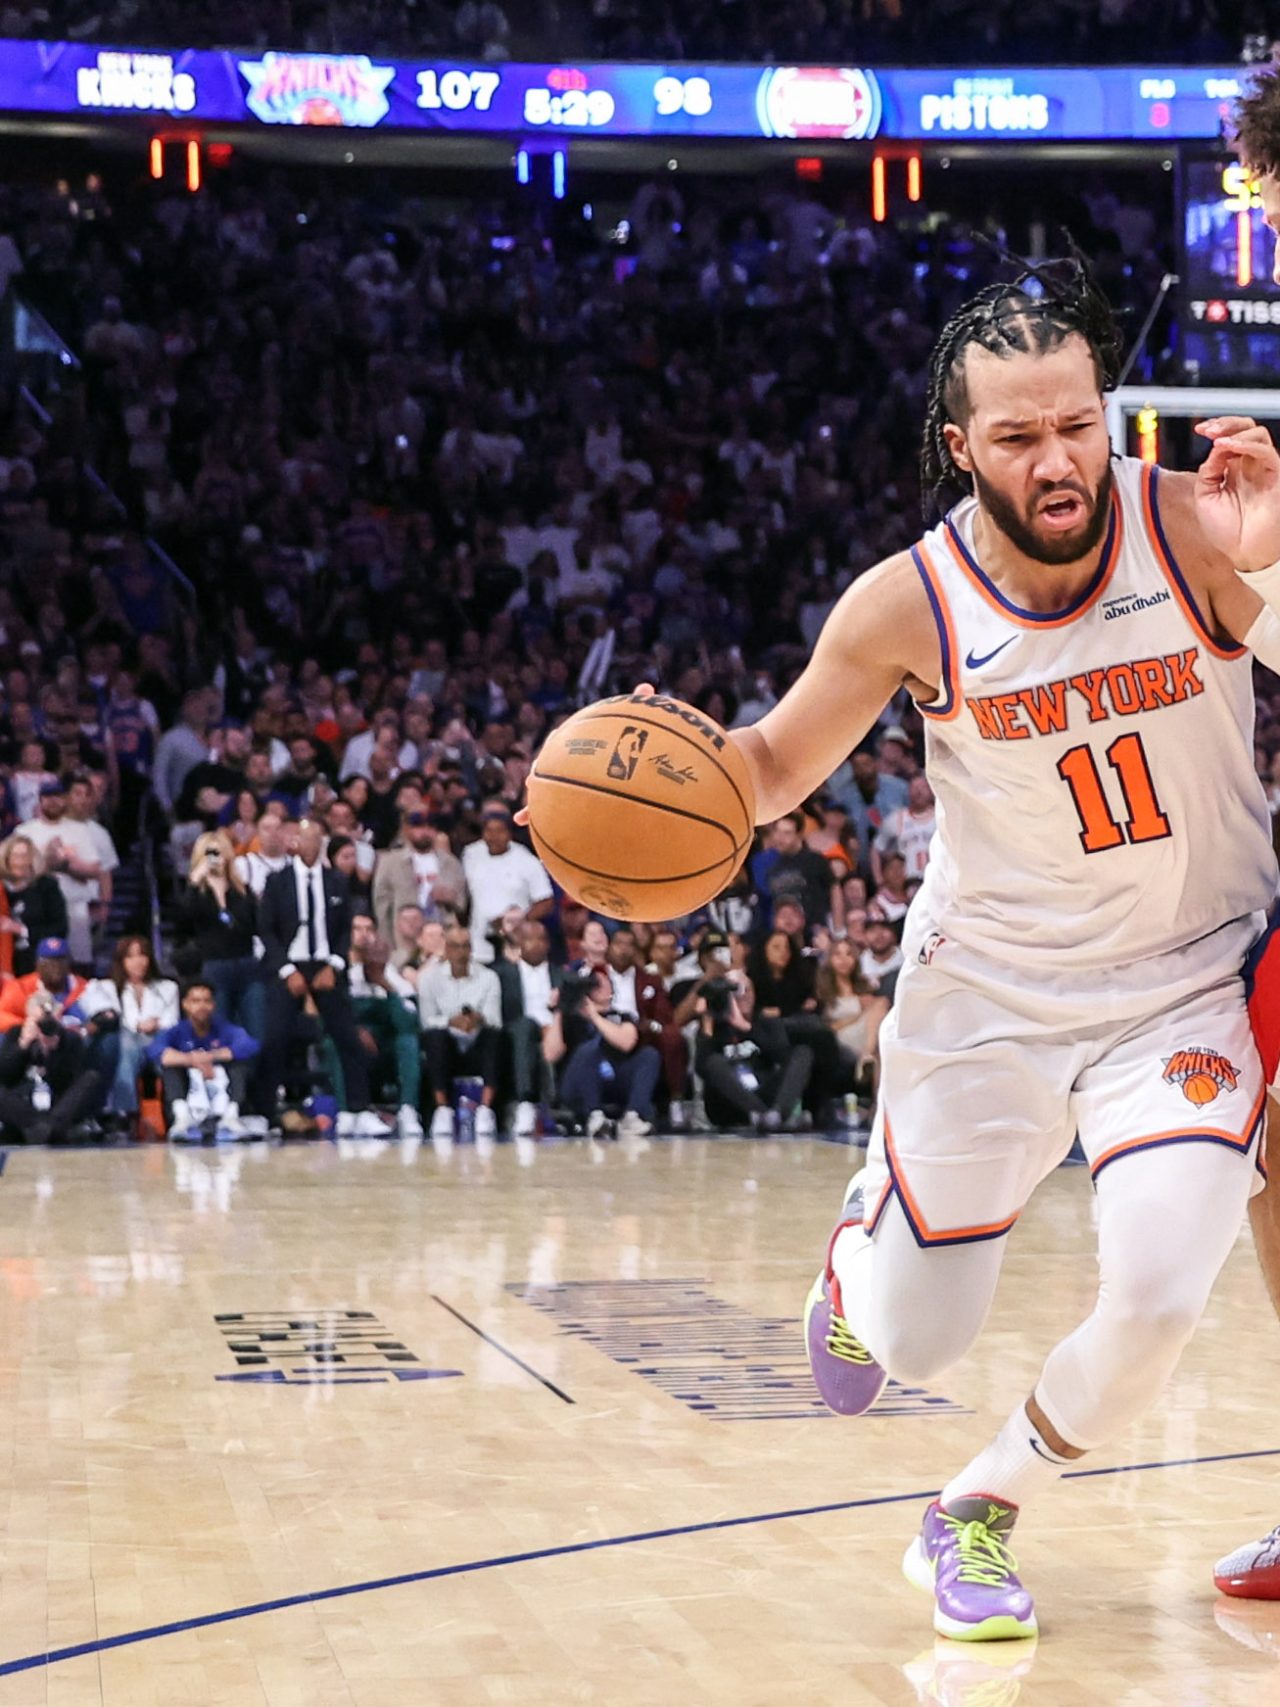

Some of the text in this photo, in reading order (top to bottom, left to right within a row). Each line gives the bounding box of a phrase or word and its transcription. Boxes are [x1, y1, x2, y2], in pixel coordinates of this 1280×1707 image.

[416, 69, 500, 110] 107
[523, 88, 615, 126] 5:29
[653, 76, 712, 116] 98
[920, 94, 1049, 131] PISTONS
[1104, 588, 1171, 621] abu dhabi
[965, 648, 1205, 741] NEW YORK
[1056, 731, 1172, 855] 11
[1163, 1050, 1237, 1092] KNICKS
